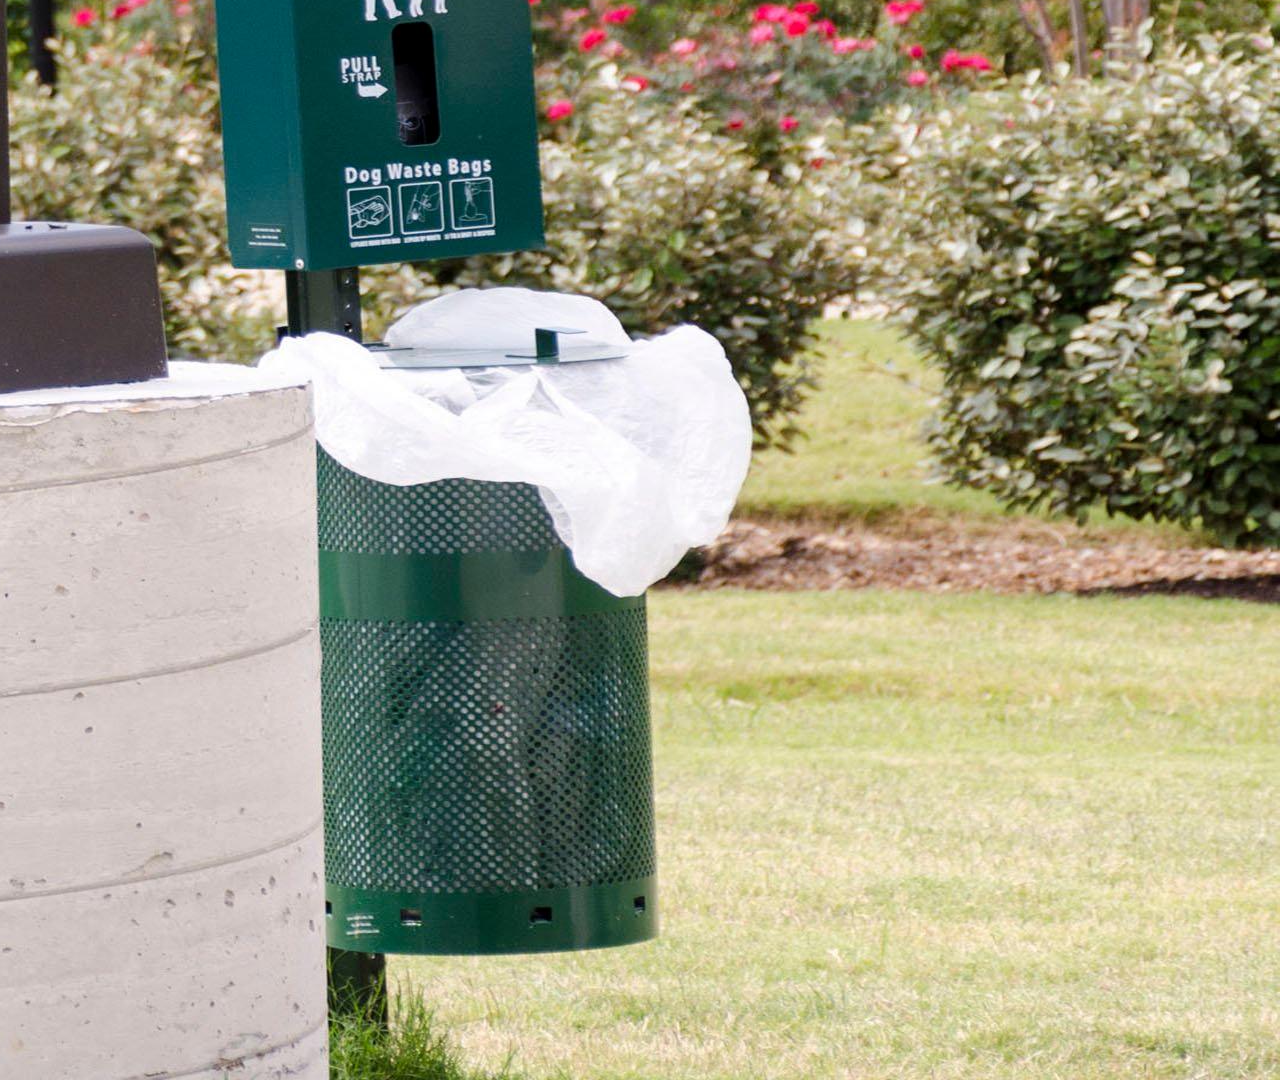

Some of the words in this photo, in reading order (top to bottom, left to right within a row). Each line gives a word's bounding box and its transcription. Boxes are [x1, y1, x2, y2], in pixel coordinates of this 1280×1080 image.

[341, 56, 381, 73] PULL
[341, 71, 382, 84] STRAP
[344, 166, 382, 185] Dog
[386, 161, 442, 180] Waste
[447, 157, 492, 176] Bags
